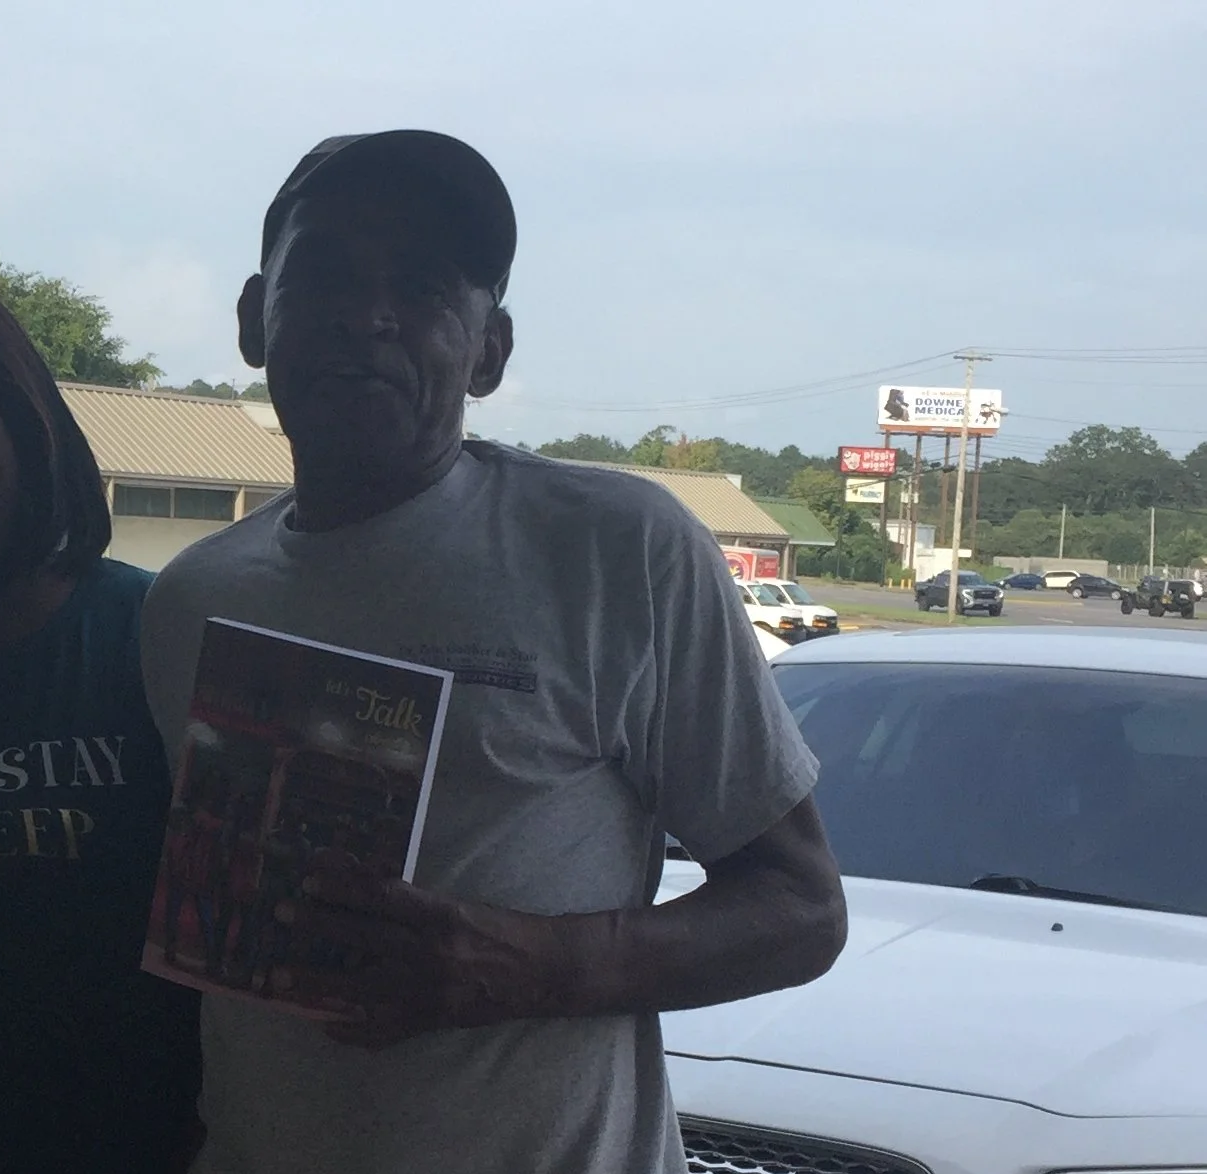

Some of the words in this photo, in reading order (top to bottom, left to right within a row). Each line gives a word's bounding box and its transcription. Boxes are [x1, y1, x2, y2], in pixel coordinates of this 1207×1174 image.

[915, 398, 971, 407] DOWNE
[914, 407, 971, 416] MEDICA
[355, 686, 423, 740] Talk
